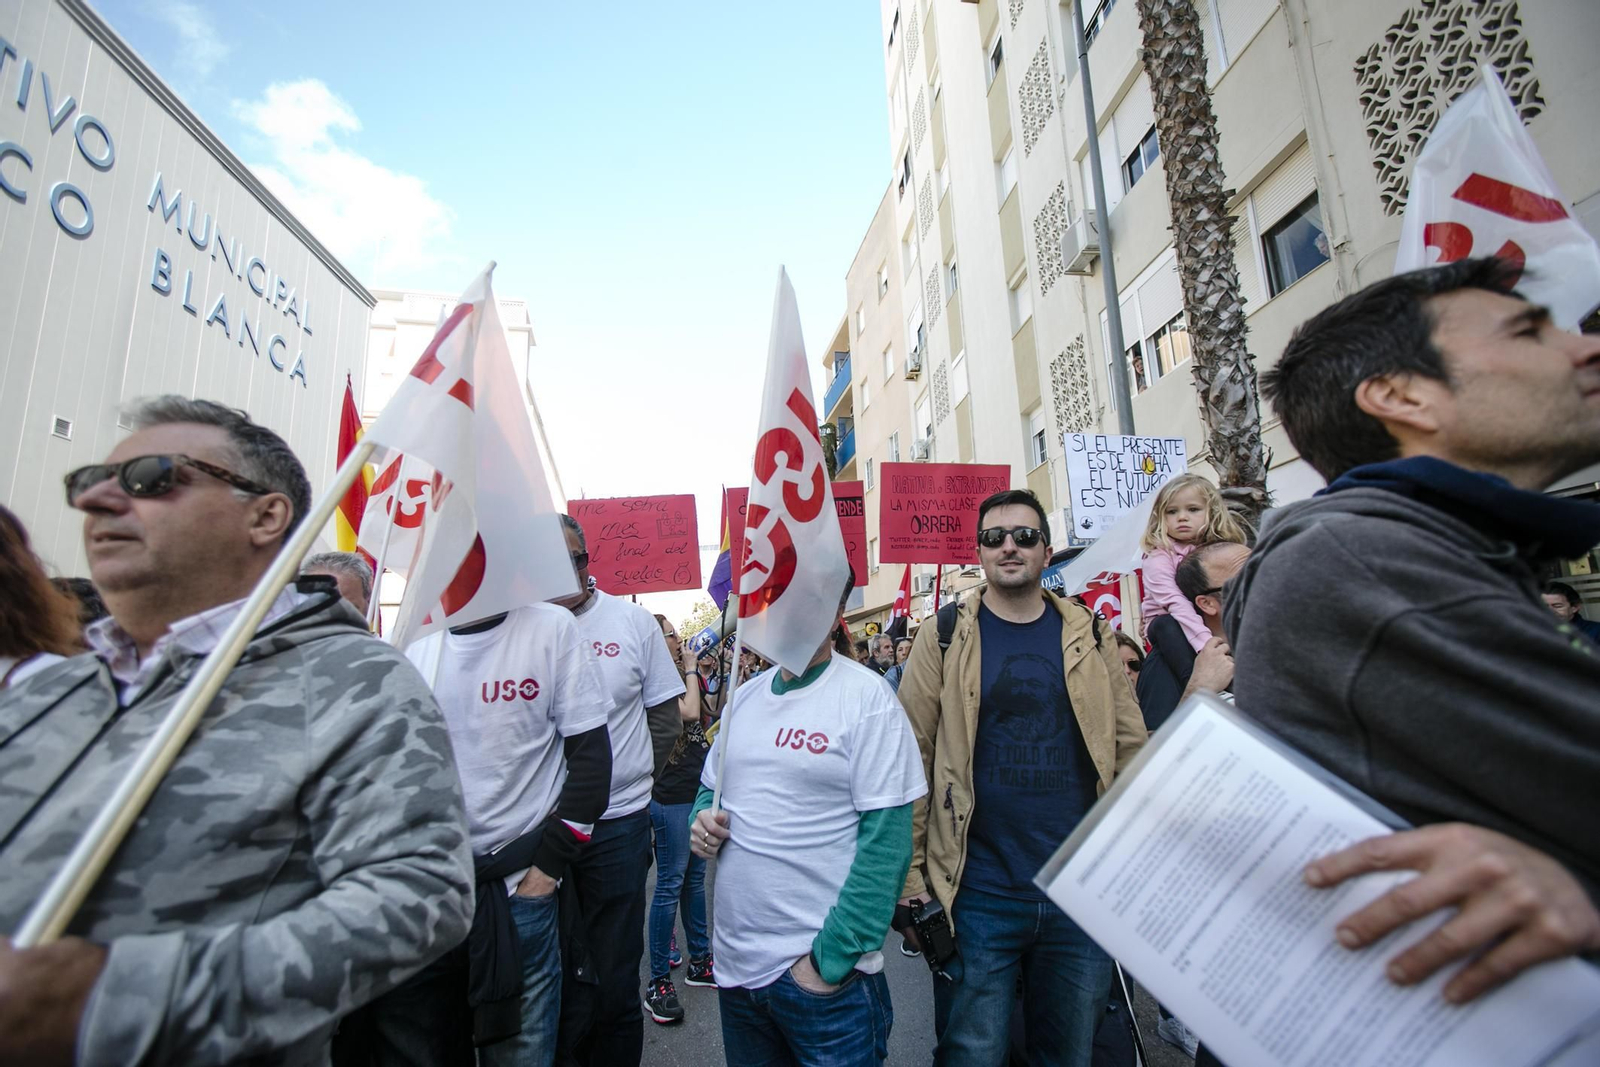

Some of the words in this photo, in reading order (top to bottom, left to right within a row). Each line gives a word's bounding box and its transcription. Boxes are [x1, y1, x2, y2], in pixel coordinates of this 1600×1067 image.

[0, 37, 115, 171] TIVO
[148, 172, 313, 336] MUNICIPAL
[0, 140, 94, 240] CO
[151, 248, 307, 388] BLANCA
[1072, 434, 1087, 452] SI
[1095, 435, 1116, 452] EL
[1122, 436, 1184, 456] PRESENTE
[1087, 452, 1107, 470] ES
[1110, 453, 1127, 471] DE
[891, 475, 936, 494] NATIVA
[1090, 470, 1112, 490] EL
[890, 499, 903, 511] LA
[906, 498, 947, 512] MISMA
[949, 496, 979, 511] CLASE
[1081, 489, 1107, 507] ES
[577, 502, 606, 518] me
[599, 521, 640, 538] mes
[910, 514, 962, 534] OBRERA
[588, 545, 601, 563] l
[615, 541, 651, 562] final
[664, 541, 688, 555] del
[614, 564, 666, 582] sueldo
[592, 641, 621, 658] SO
[482, 677, 541, 704] USO
[774, 727, 830, 755] USO
[1005, 745, 1040, 765] TOLD
[1045, 746, 1068, 766] YOU
[999, 767, 1030, 788] WAS
[1033, 769, 1070, 789] RIGHT
